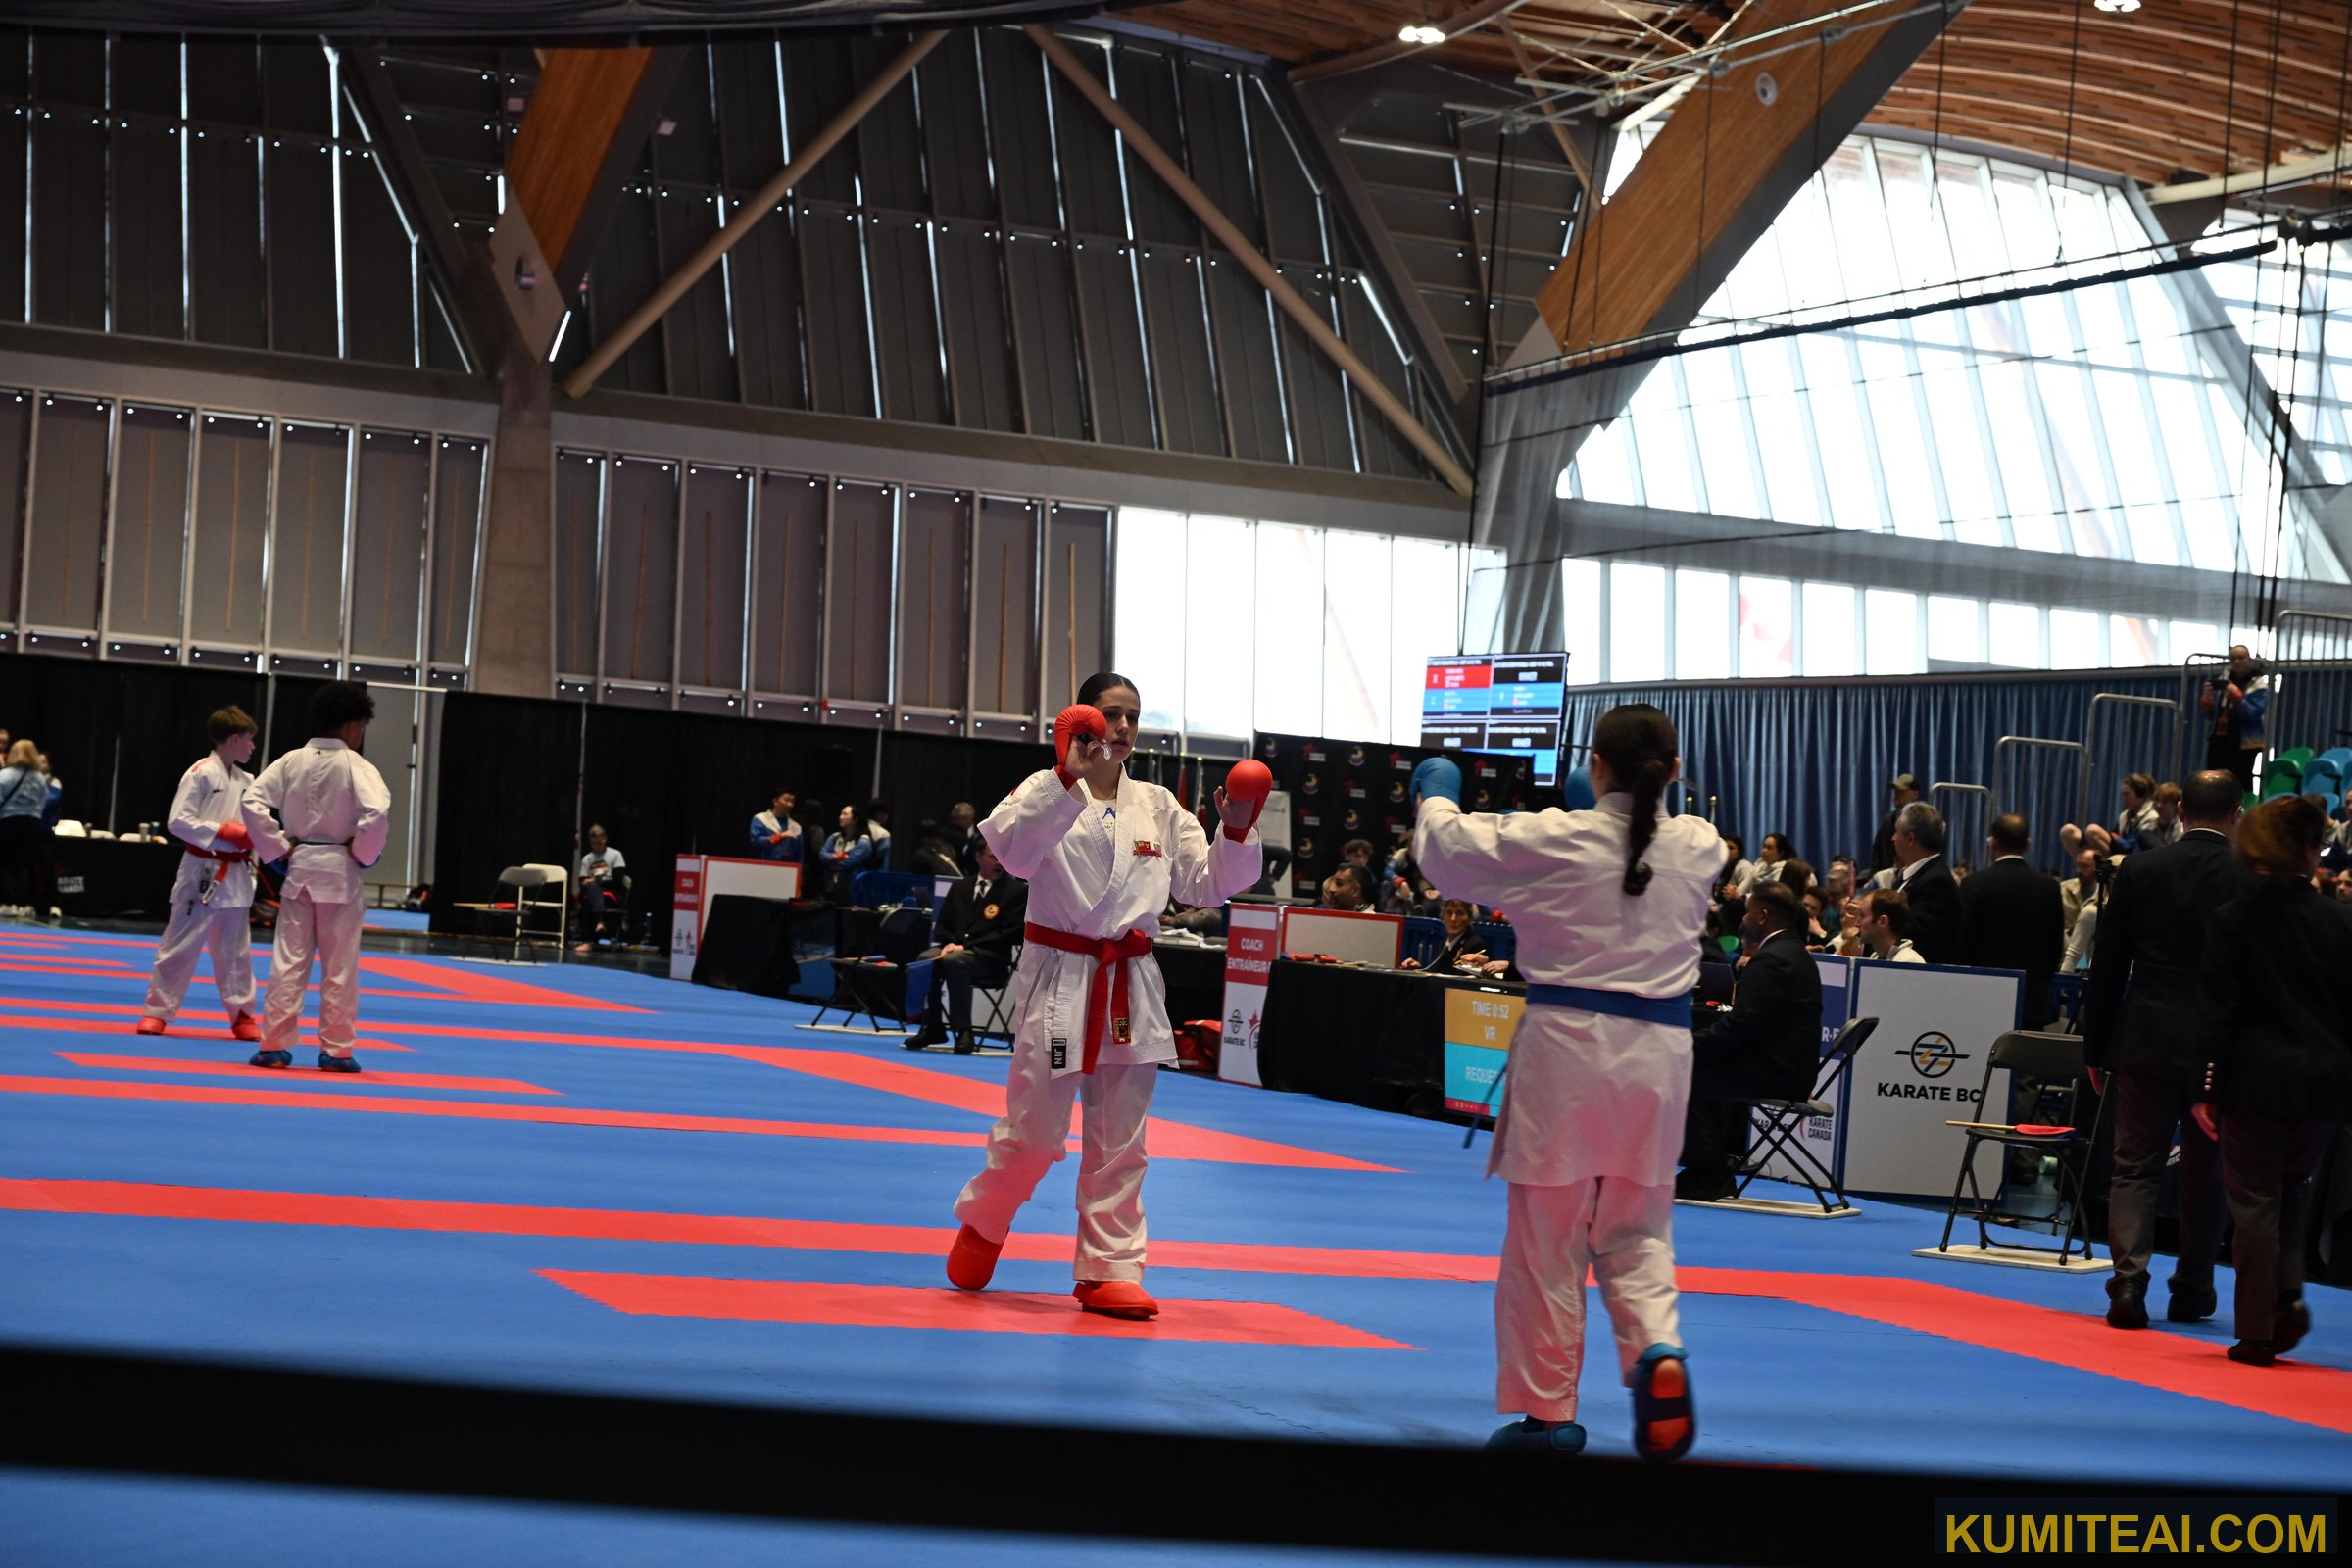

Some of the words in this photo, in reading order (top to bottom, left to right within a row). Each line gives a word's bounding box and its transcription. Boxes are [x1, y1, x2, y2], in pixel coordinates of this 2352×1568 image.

[1241, 938, 1264, 952] COACH
[1472, 1001, 1491, 1017] TIME
[1484, 1025, 1496, 1041] VR
[1466, 1066, 1505, 1085] REQUE
[1877, 1082, 1951, 1101] KARATE
[1956, 1088, 1983, 1102] BC
[1809, 1117, 1833, 1130] KARATE
[1808, 1128, 1832, 1141] CANADA
